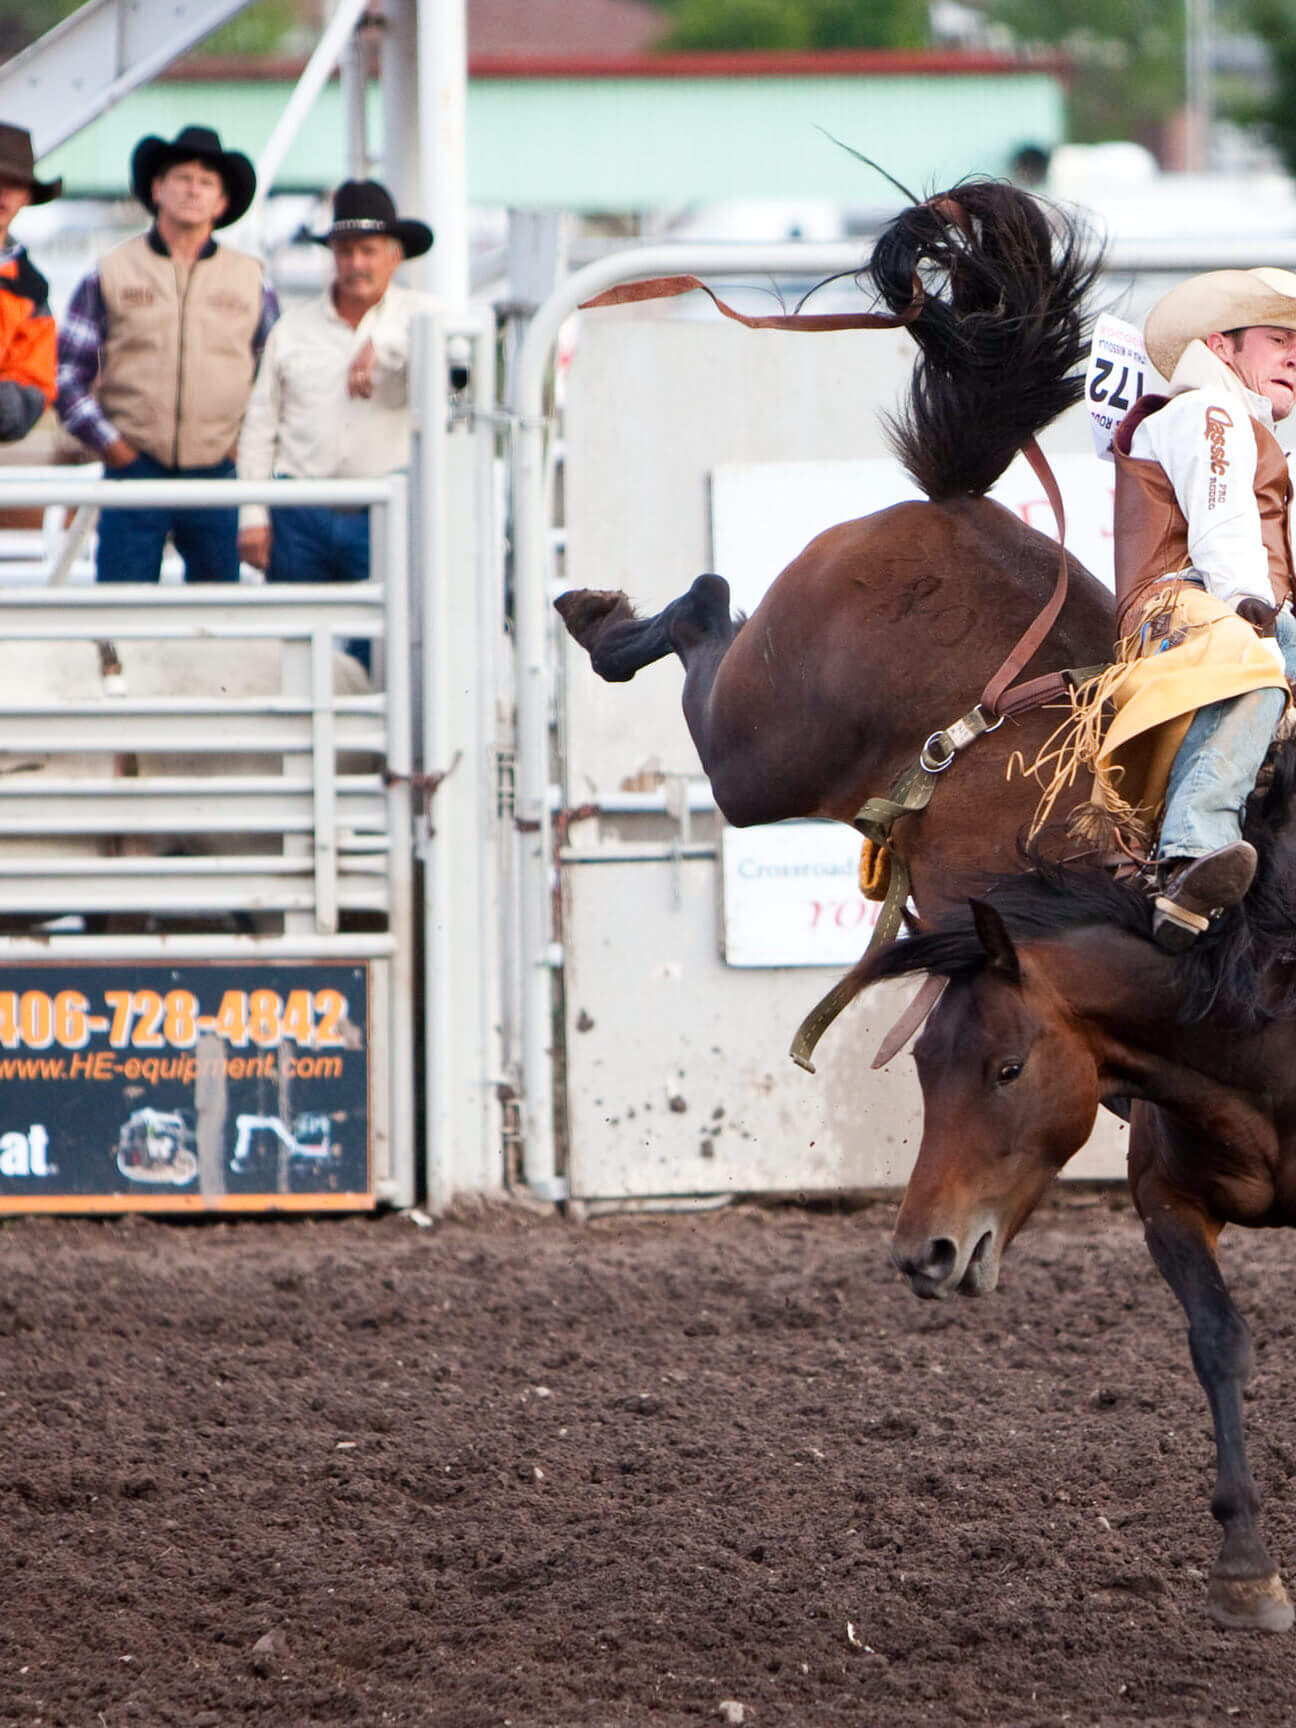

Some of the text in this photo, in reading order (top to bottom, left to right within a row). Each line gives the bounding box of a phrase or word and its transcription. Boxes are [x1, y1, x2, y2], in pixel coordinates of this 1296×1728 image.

[1089, 357, 1144, 411] 172
[1204, 405, 1234, 476] Classic
[737, 858, 858, 879] Crossroad
[0, 988, 350, 1049] 406-728-4842
